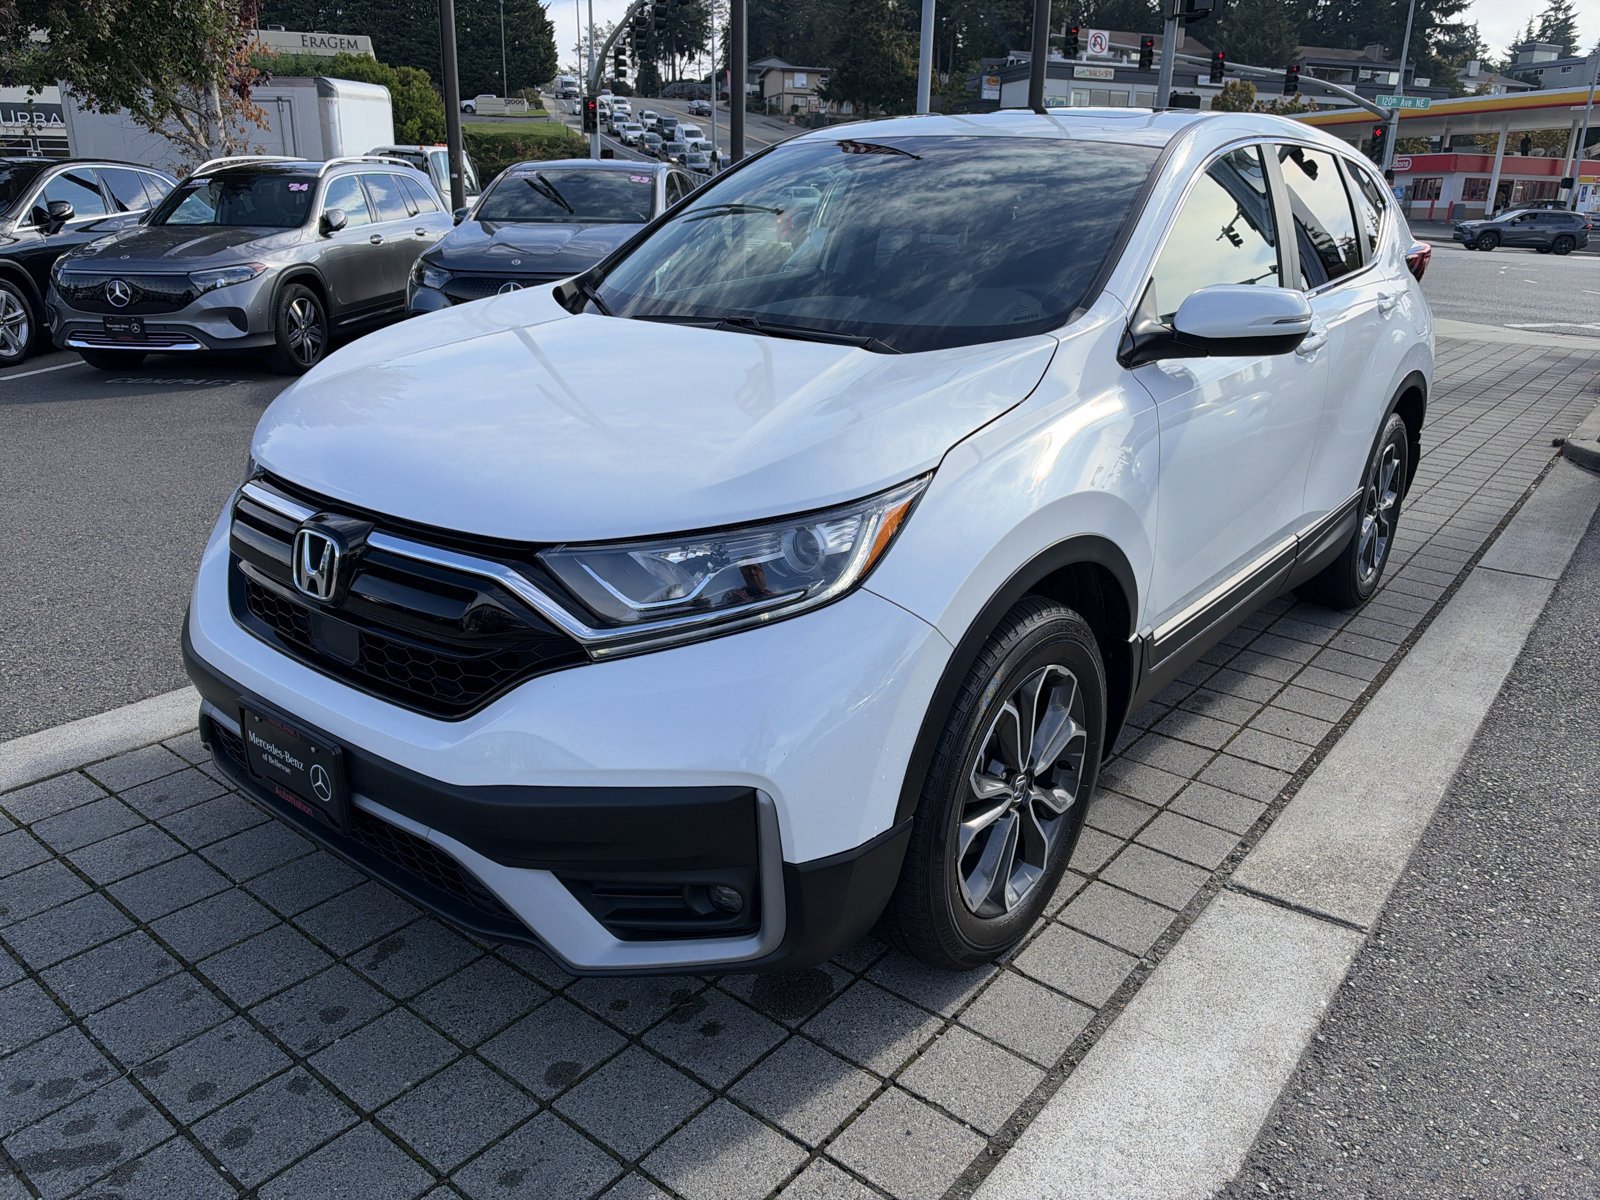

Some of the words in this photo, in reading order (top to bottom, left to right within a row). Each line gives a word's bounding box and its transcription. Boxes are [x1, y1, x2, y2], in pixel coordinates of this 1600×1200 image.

[1400, 98, 1412, 107] Ave
[1415, 99, 1425, 108] NE
[248, 730, 304, 771] Mercedes-Benz
[262, 753, 268, 762] of
[268, 755, 291, 774] Bellevue
